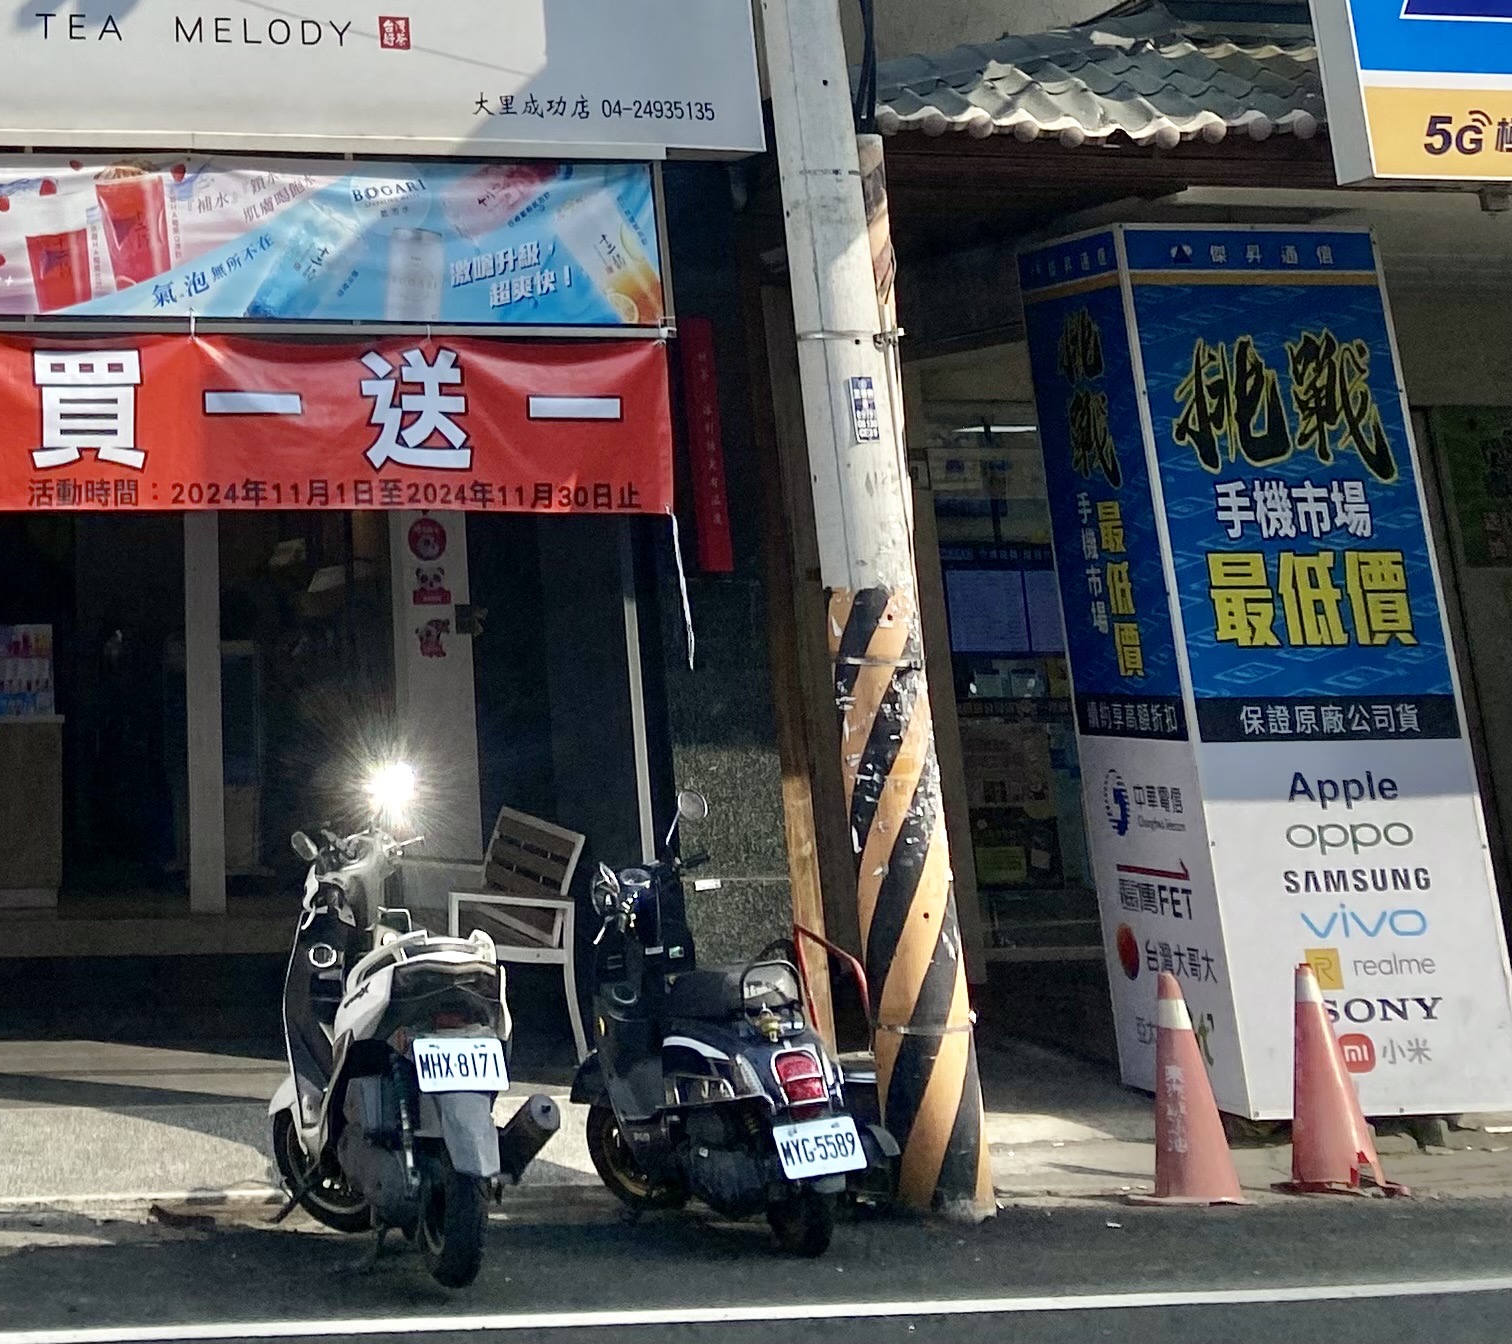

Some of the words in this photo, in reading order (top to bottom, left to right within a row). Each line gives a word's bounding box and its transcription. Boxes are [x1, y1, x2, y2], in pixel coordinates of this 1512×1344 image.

[35, 13, 123, 43] TEA
[175, 16, 352, 49] MELODY
[473, 92, 591, 120] 大里成功店
[601, 99, 716, 121] 04-24935135
[353, 179, 428, 203] BOGARI
[1210, 245, 1334, 265] 傑昇通信
[29, 346, 622, 473] 買一送一
[1173, 330, 1398, 482] 挑戰
[1216, 481, 1372, 539] 手機市場
[1077, 492, 1110, 634] 手機市場
[1097, 501, 1144, 678] 最低價
[1206, 550, 1418, 648] 最低價
[1240, 705, 1420, 734] 保證原廠公司貨
[1288, 771, 1398, 808] Apple
[1284, 868, 1431, 894] SAMSUNG
[1300, 903, 1427, 939] vivo
[1145, 939, 1218, 983] 台灣大哥大
[1353, 953, 1436, 976] realme
[1323, 997, 1442, 1023] SONY
[1382, 1038, 1432, 1064] 小米
